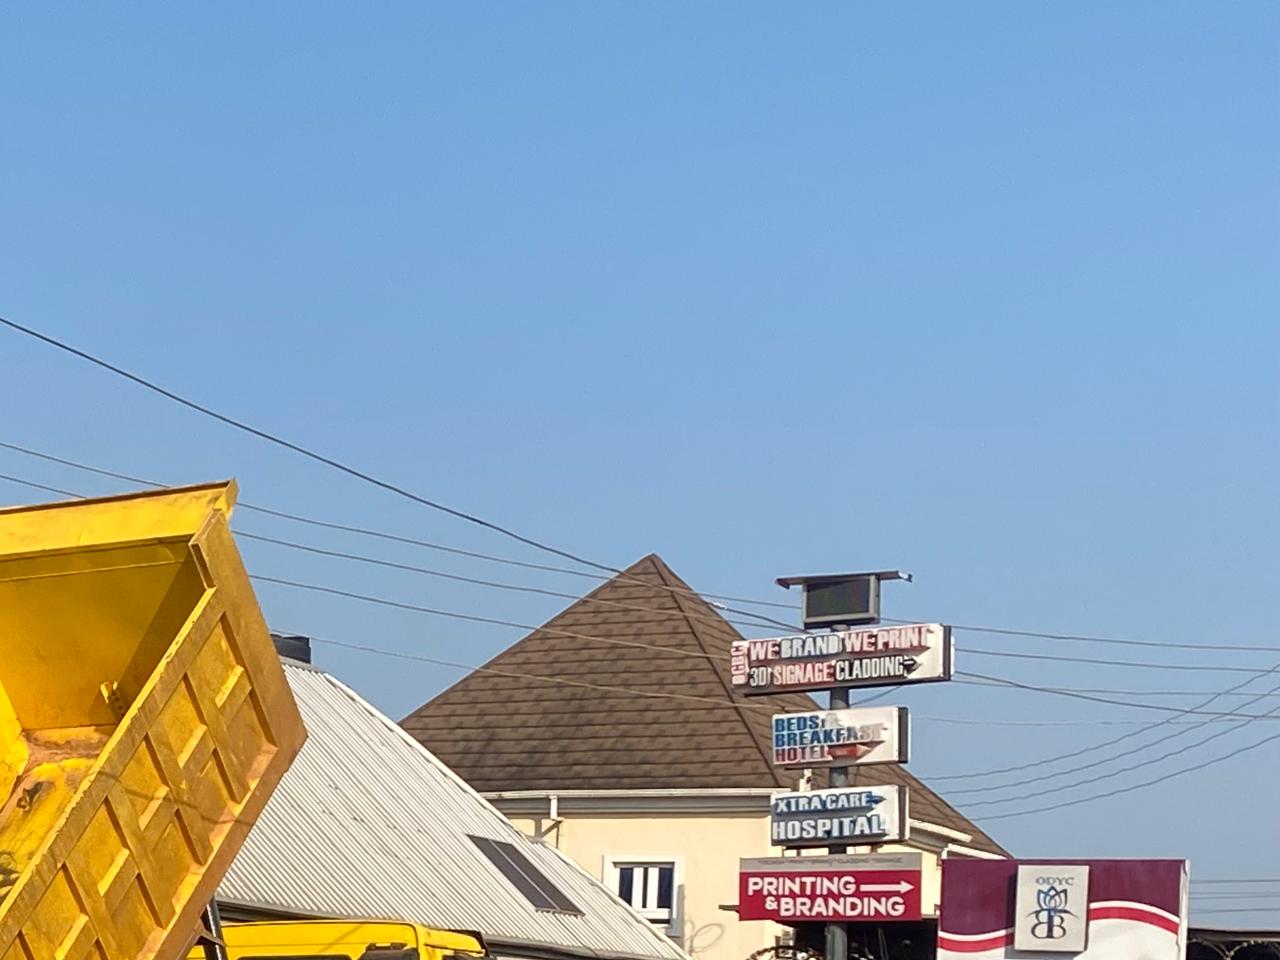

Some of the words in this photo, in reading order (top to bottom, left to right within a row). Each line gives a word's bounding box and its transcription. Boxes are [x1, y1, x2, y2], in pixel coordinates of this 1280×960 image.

[750, 641, 779, 660] WE
[781, 635, 840, 658] BRAND
[844, 632, 875, 652] WE
[877, 627, 928, 650] PRINT
[773, 662, 834, 685] SIGNAGE
[836, 656, 904, 680] CLADDING
[775, 715, 820, 732] BEDS
[775, 723, 883, 747] BREAKFAST
[775, 745, 828, 762] HOTEL
[776, 795, 823, 813] XTRA
[826, 792, 873, 810] CARE
[772, 815, 885, 839] HOSPITAL
[747, 876, 857, 896] PRINTING
